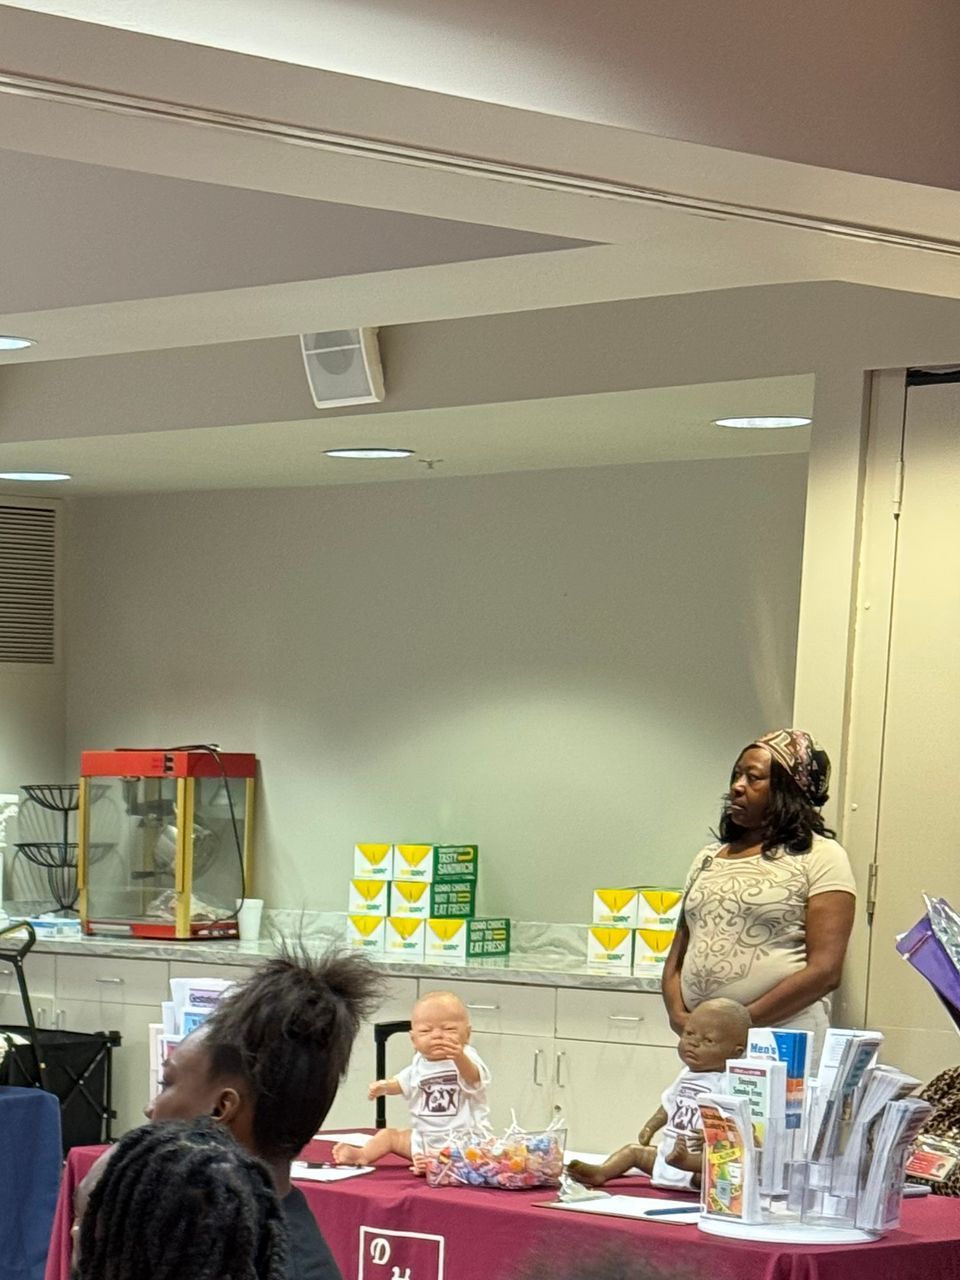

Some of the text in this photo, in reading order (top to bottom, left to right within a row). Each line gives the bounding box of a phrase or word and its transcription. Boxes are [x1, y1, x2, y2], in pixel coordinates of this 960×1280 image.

[437, 863, 474, 875] SANDWICH
[434, 904, 447, 915] EAT
[448, 903, 471, 915] FRESH
[469, 942, 482, 953] EAT
[483, 941, 506, 953] FRESH
[750, 1043, 777, 1055] Men's
